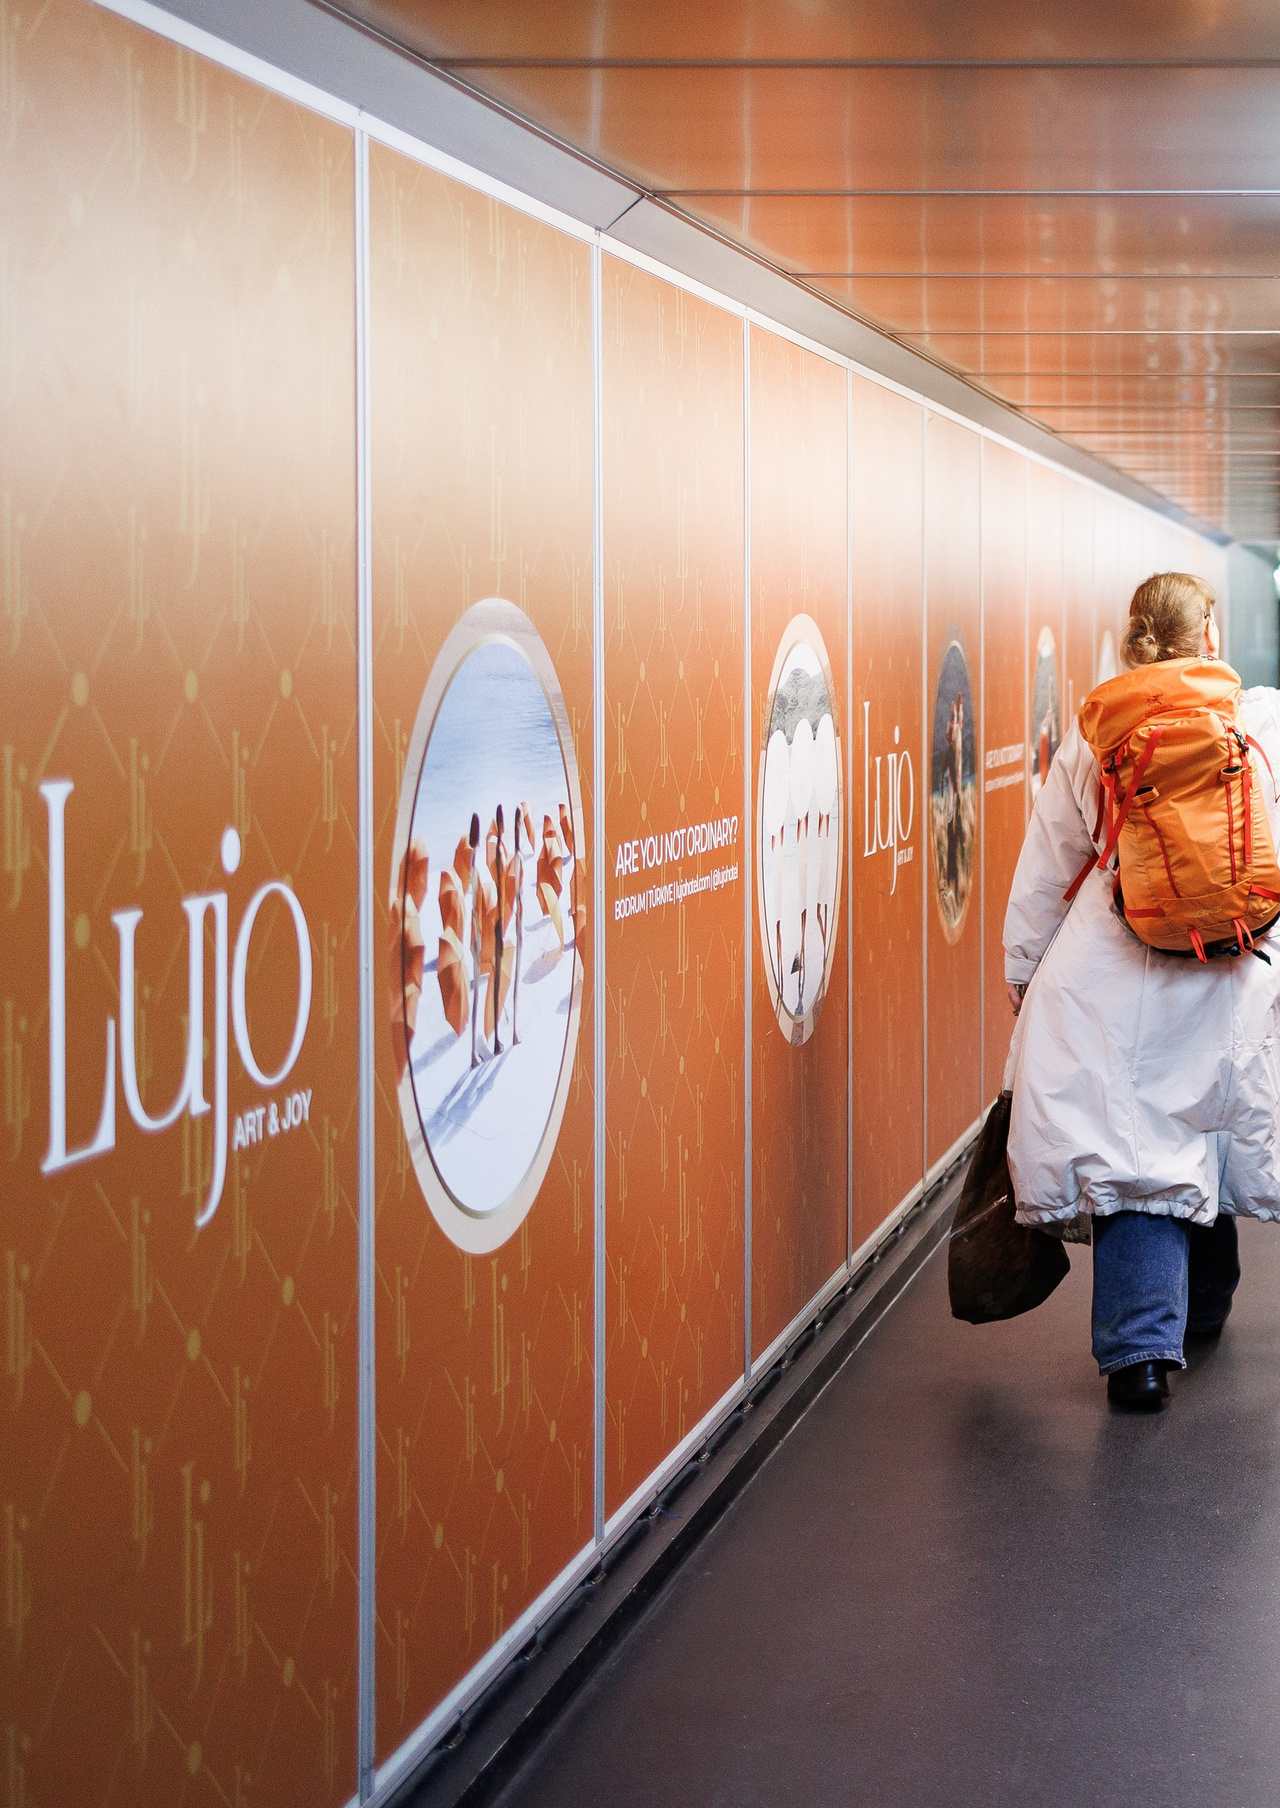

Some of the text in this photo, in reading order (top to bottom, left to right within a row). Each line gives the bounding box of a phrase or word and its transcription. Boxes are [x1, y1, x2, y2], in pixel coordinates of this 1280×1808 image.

[863, 701, 914, 895] Lujo
[615, 815, 738, 878] ARE YOU NOT ORDINARY?
[615, 892, 645, 920] BODRUM
[676, 874, 710, 903] lujohotel.com
[713, 861, 739, 891] @lujohotel
[39, 776, 313, 1227] Lujo
[233, 1088, 312, 1152] ART & JOY
